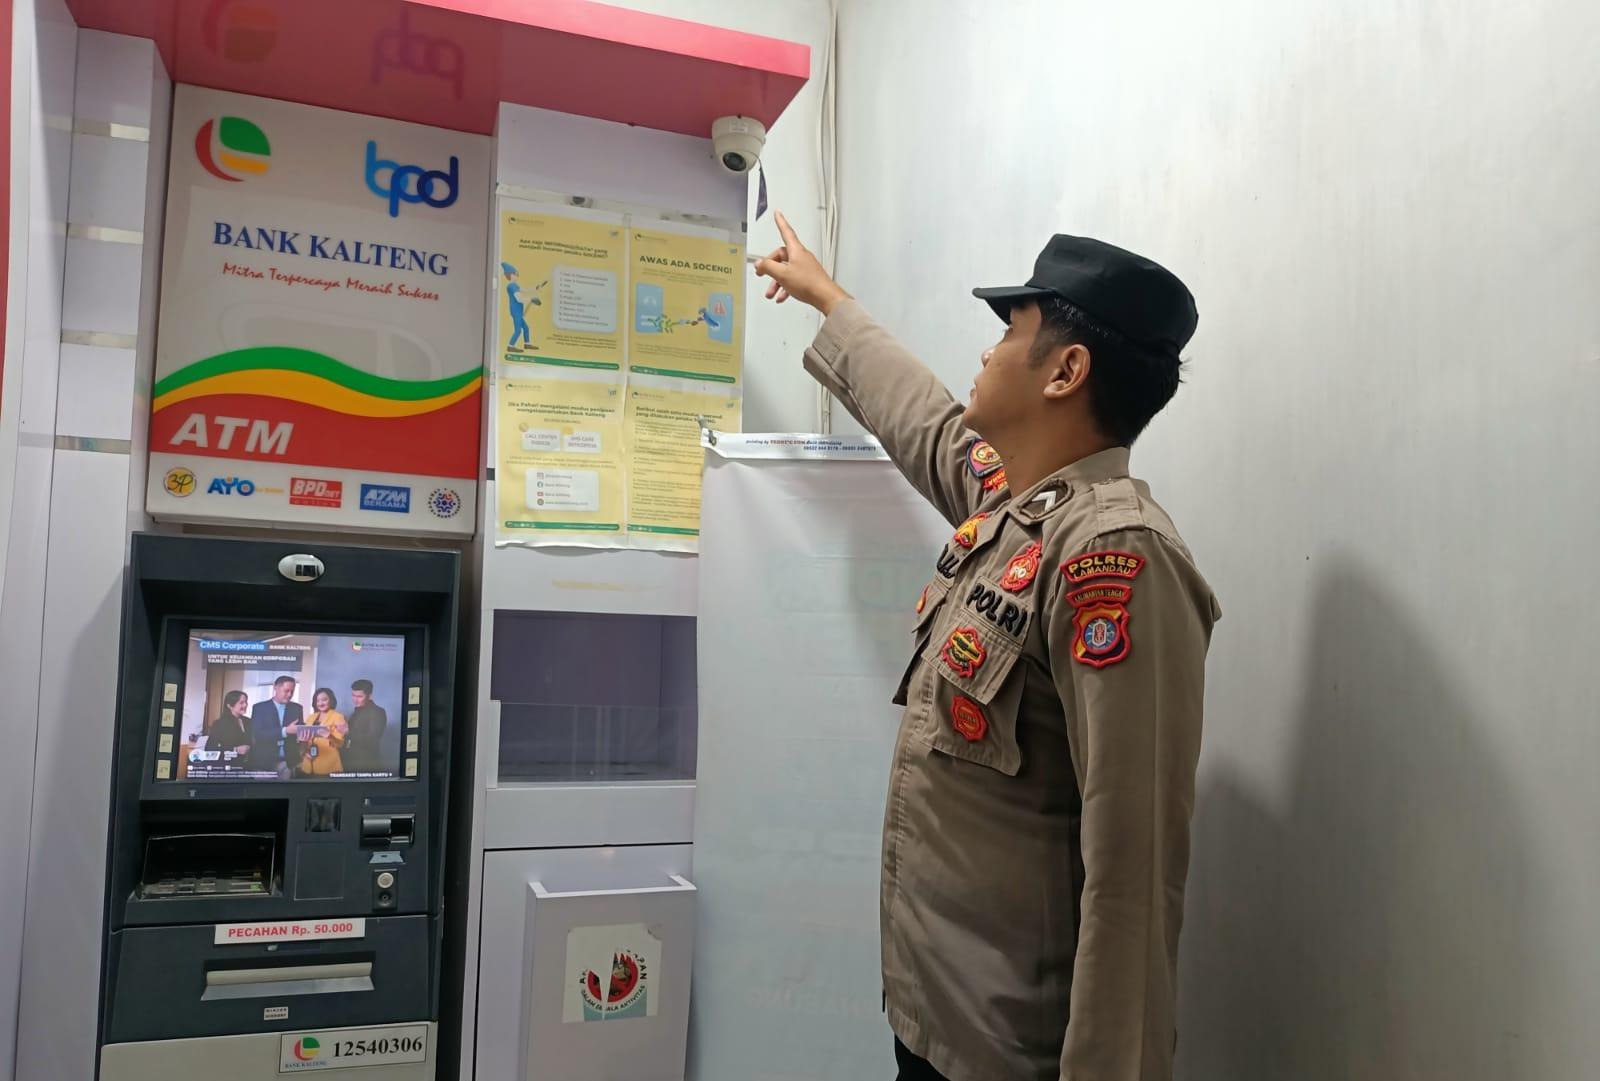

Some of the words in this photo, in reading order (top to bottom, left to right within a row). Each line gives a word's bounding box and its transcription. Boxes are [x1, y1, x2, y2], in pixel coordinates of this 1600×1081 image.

[364, 140, 459, 217] bpd
[213, 221, 300, 255] BANK
[309, 234, 448, 276] KALTENG
[640, 255, 668, 266] AWAS
[670, 260, 690, 269] ADA
[693, 262, 733, 275] SOCENG!
[222, 262, 264, 278] Mitra
[269, 267, 341, 291] Terpercaya
[346, 277, 393, 294] Meraih
[397, 284, 439, 300] Sukses
[169, 412, 294, 455] ATM
[207, 476, 255, 497] AYO
[1068, 555, 1138, 573] POLRES
[1073, 565, 1131, 579] LAMANDAU
[966, 583, 1028, 637] POLRI
[200, 641, 220, 649] CMS
[222, 642, 265, 651] Corporate
[228, 926, 288, 938] PECAHAN
[291, 925, 311, 936] Rp.
[314, 923, 353, 934] 50.000
[333, 1036, 423, 1058] 12540306
